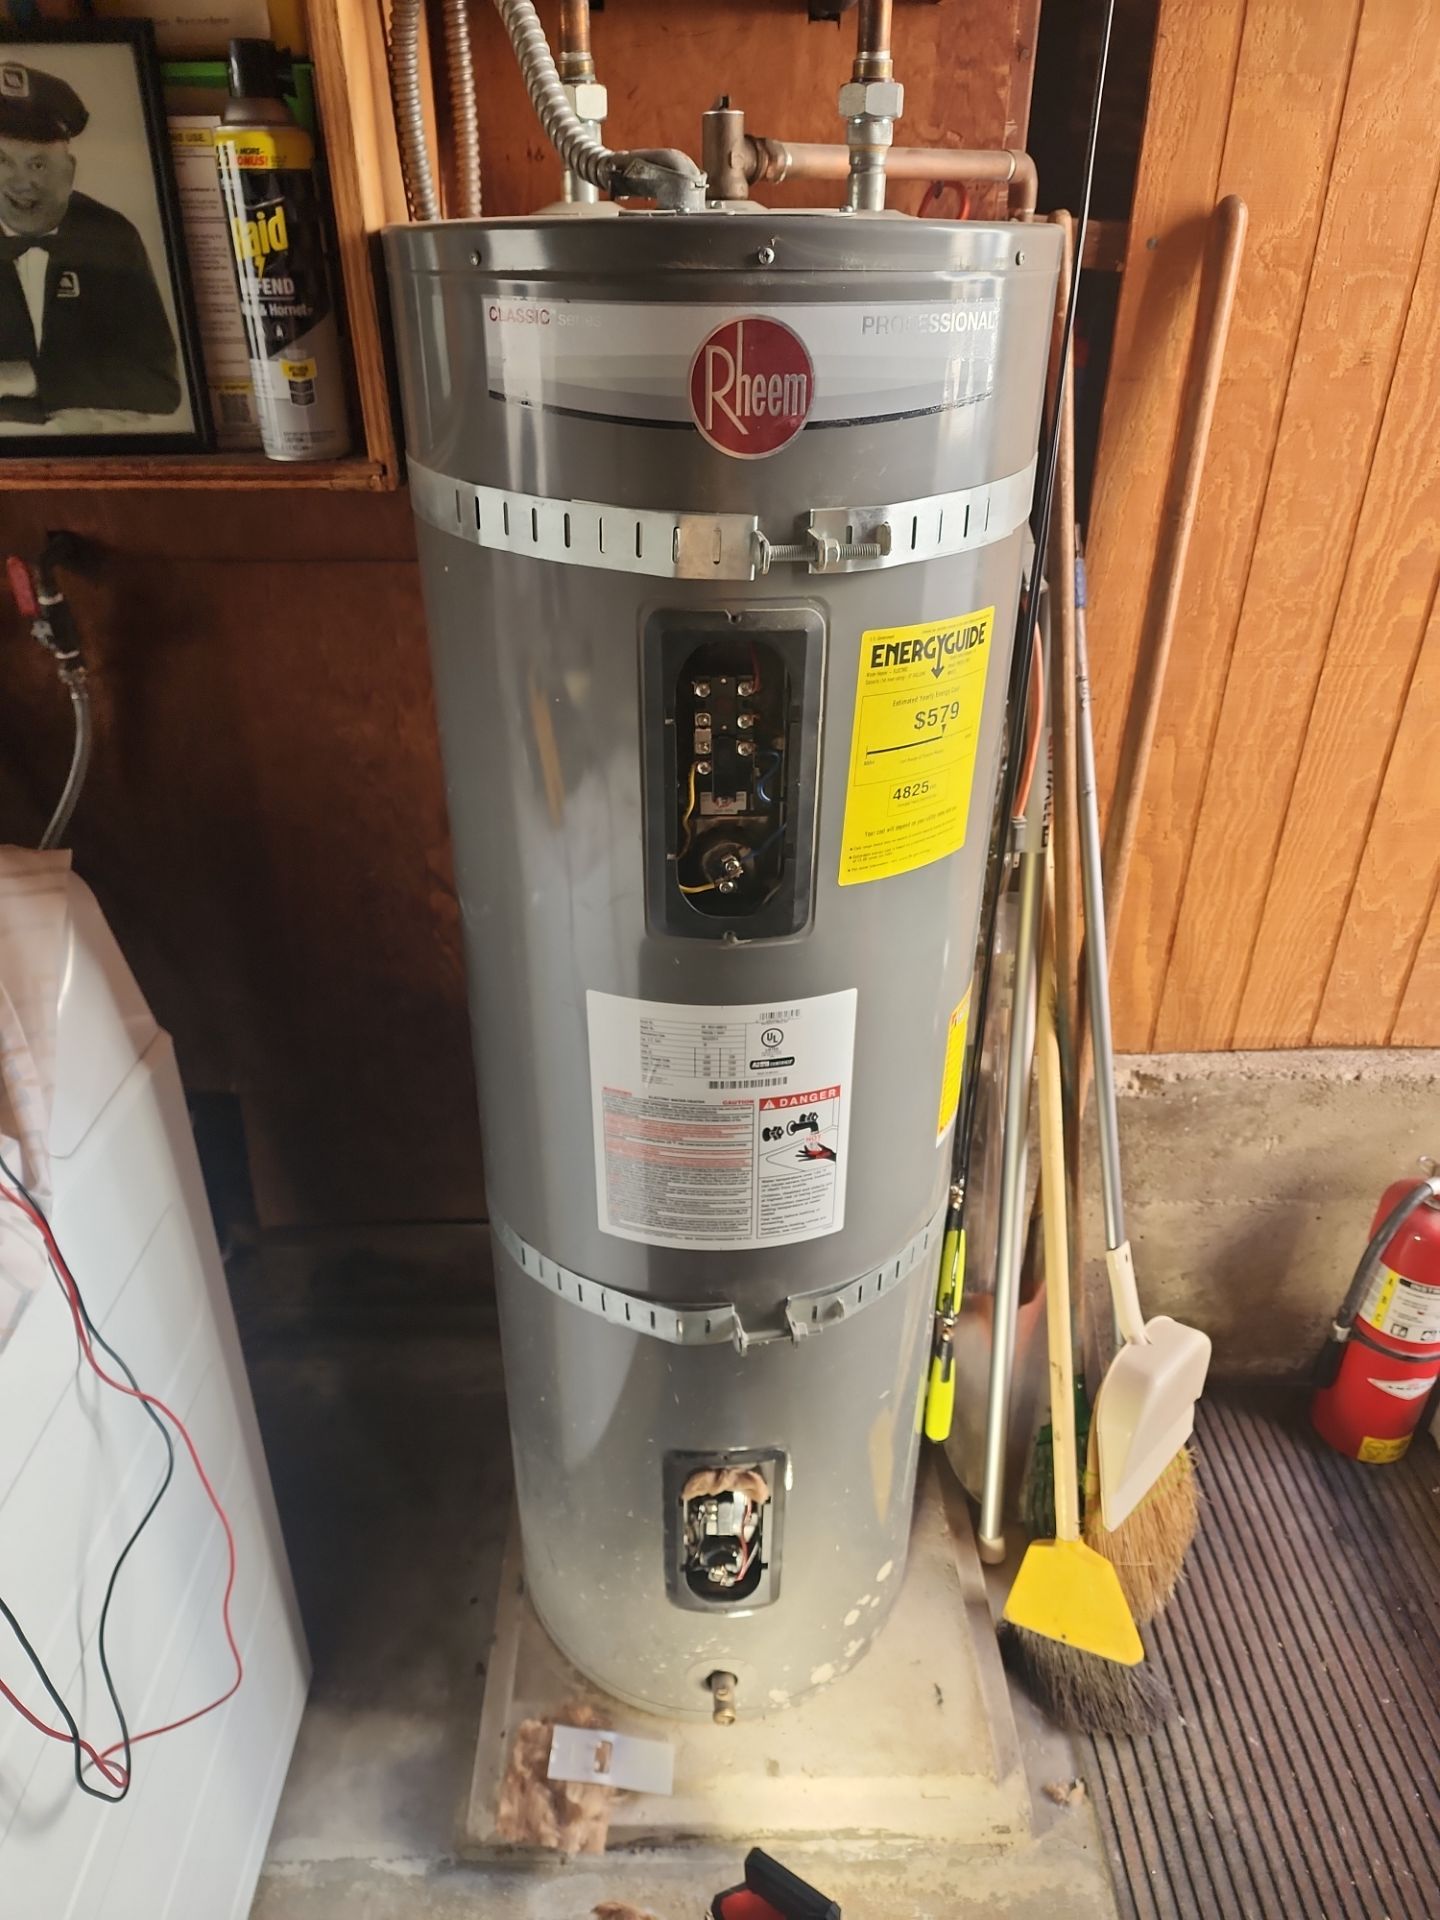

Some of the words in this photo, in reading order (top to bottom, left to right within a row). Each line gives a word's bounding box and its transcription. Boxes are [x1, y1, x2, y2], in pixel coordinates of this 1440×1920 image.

[230, 156, 268, 166] ONUS!
[242, 277, 295, 295] FEND
[489, 306, 551, 325] CLASSIC
[862, 311, 995, 335] PROESSIONAL
[705, 321, 807, 435] Rheem
[870, 622, 987, 672] ENERGYGUIDE
[914, 701, 960, 730] $579
[893, 780, 930, 800] 4825
[766, 1032, 779, 1043] UL
[779, 1088, 836, 1107] DANGER
